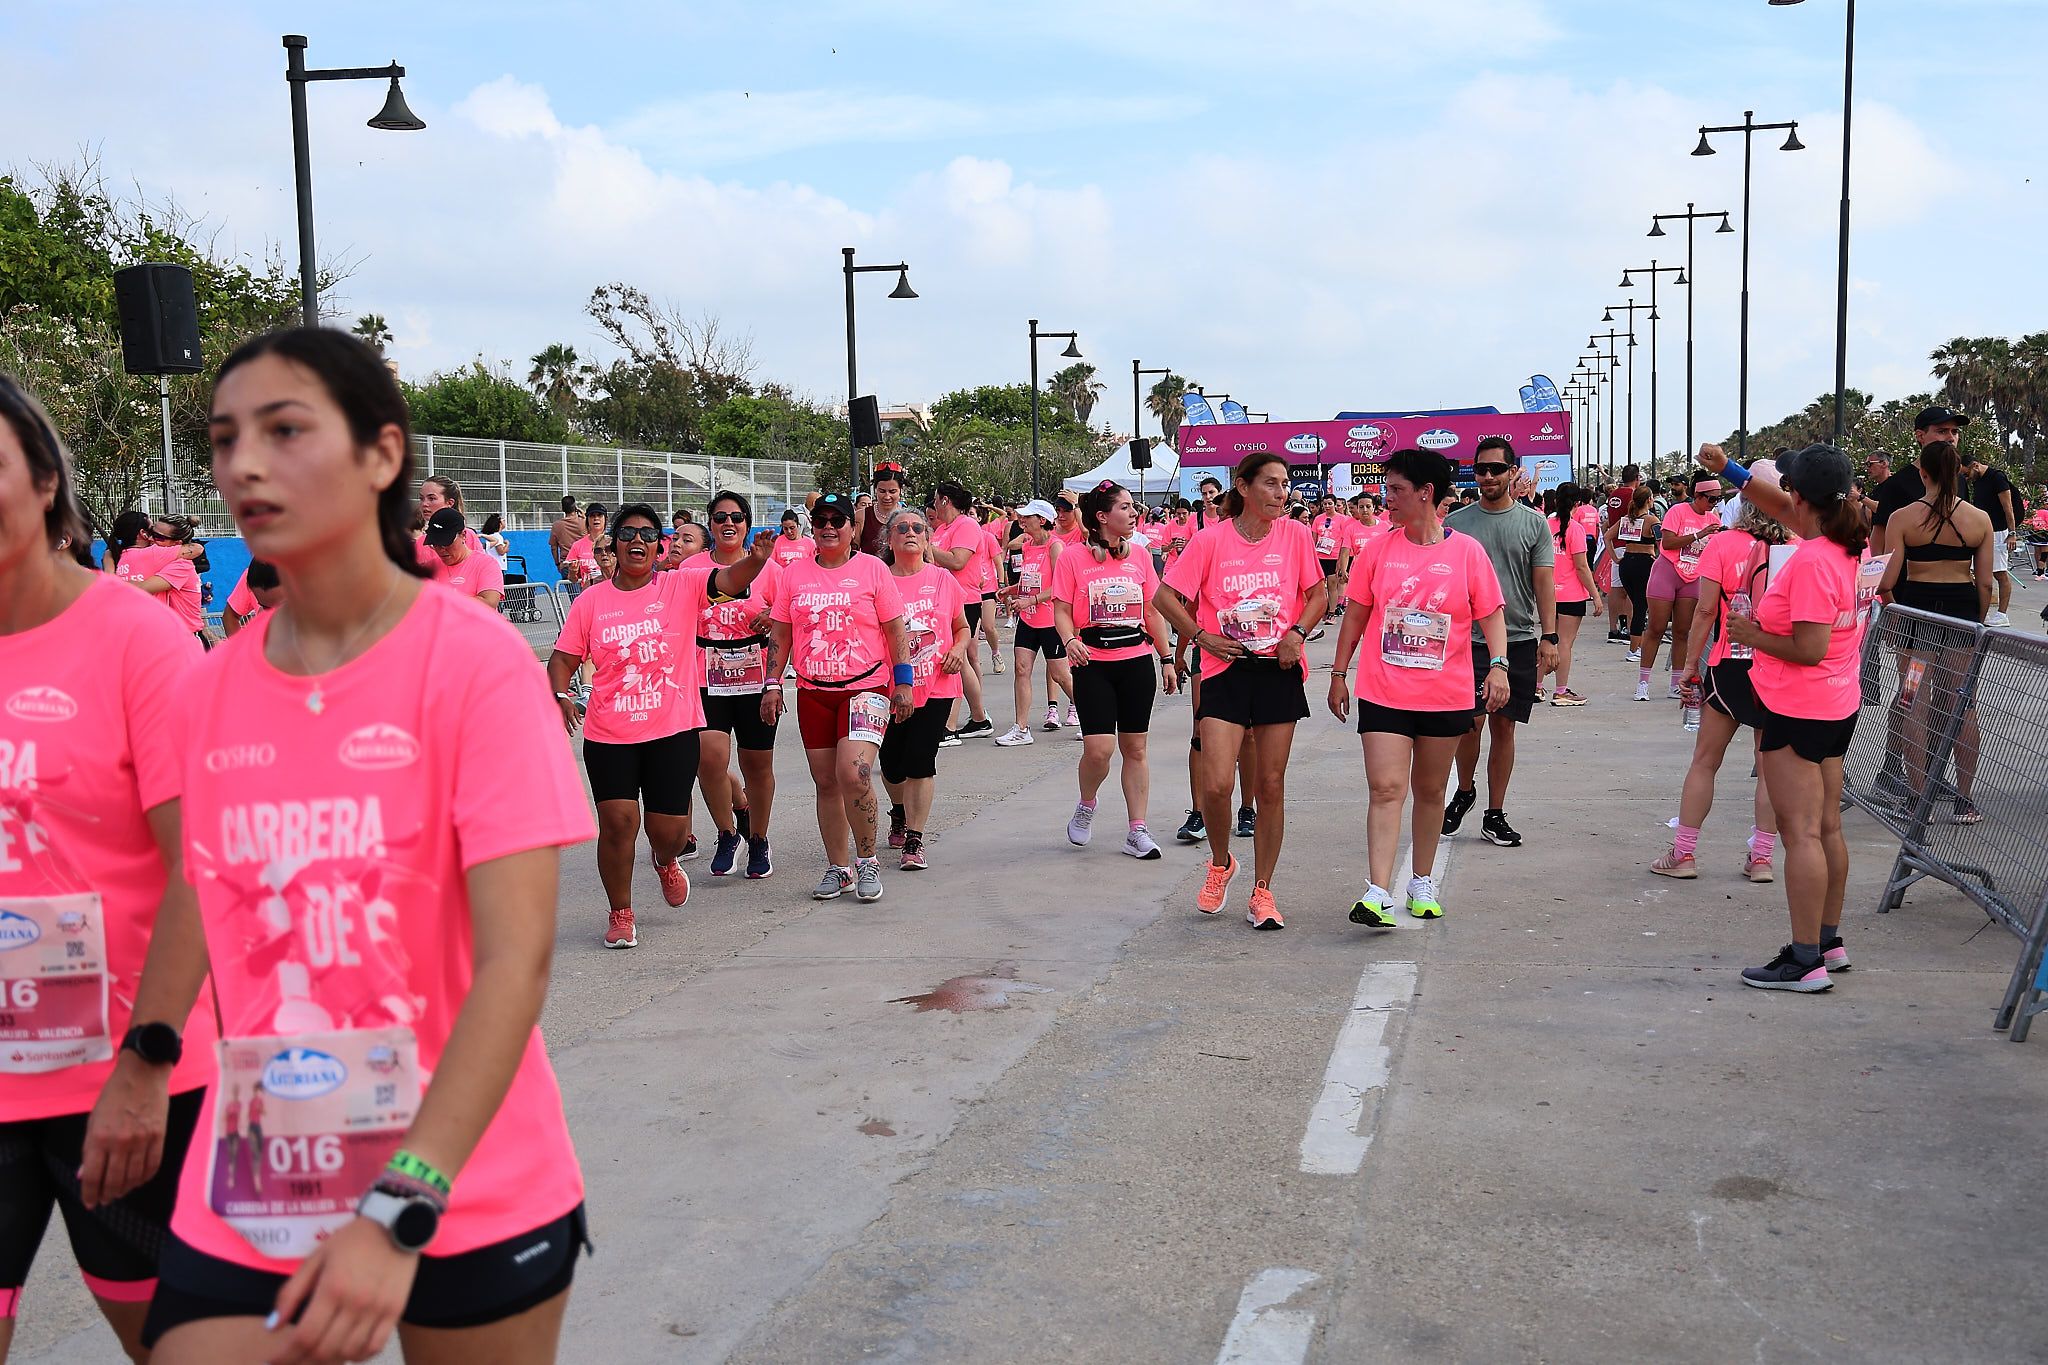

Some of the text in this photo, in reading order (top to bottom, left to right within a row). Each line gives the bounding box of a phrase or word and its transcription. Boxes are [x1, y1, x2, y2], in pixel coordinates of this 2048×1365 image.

[1234, 442, 1268, 451] OYSHO
[1289, 441, 1324, 449] ASTURIAA
[1344, 439, 1373, 448] Carrera
[1419, 437, 1456, 445] ASTURIANA
[1361, 446, 1382, 460] Mujer
[1107, 603, 1127, 613] 016
[598, 610, 624, 621] OYSHO
[1403, 635, 1427, 647] 016
[724, 668, 746, 678] 016
[806, 660, 847, 676] MUJER
[614, 691, 662, 713] MUJER
[630, 712, 648, 722] 2026
[206, 743, 276, 773] OYSHO
[38, 1025, 84, 1040] VALENCIA
[26, 1047, 87, 1063] Santander
[268, 1134, 344, 1173] 016
